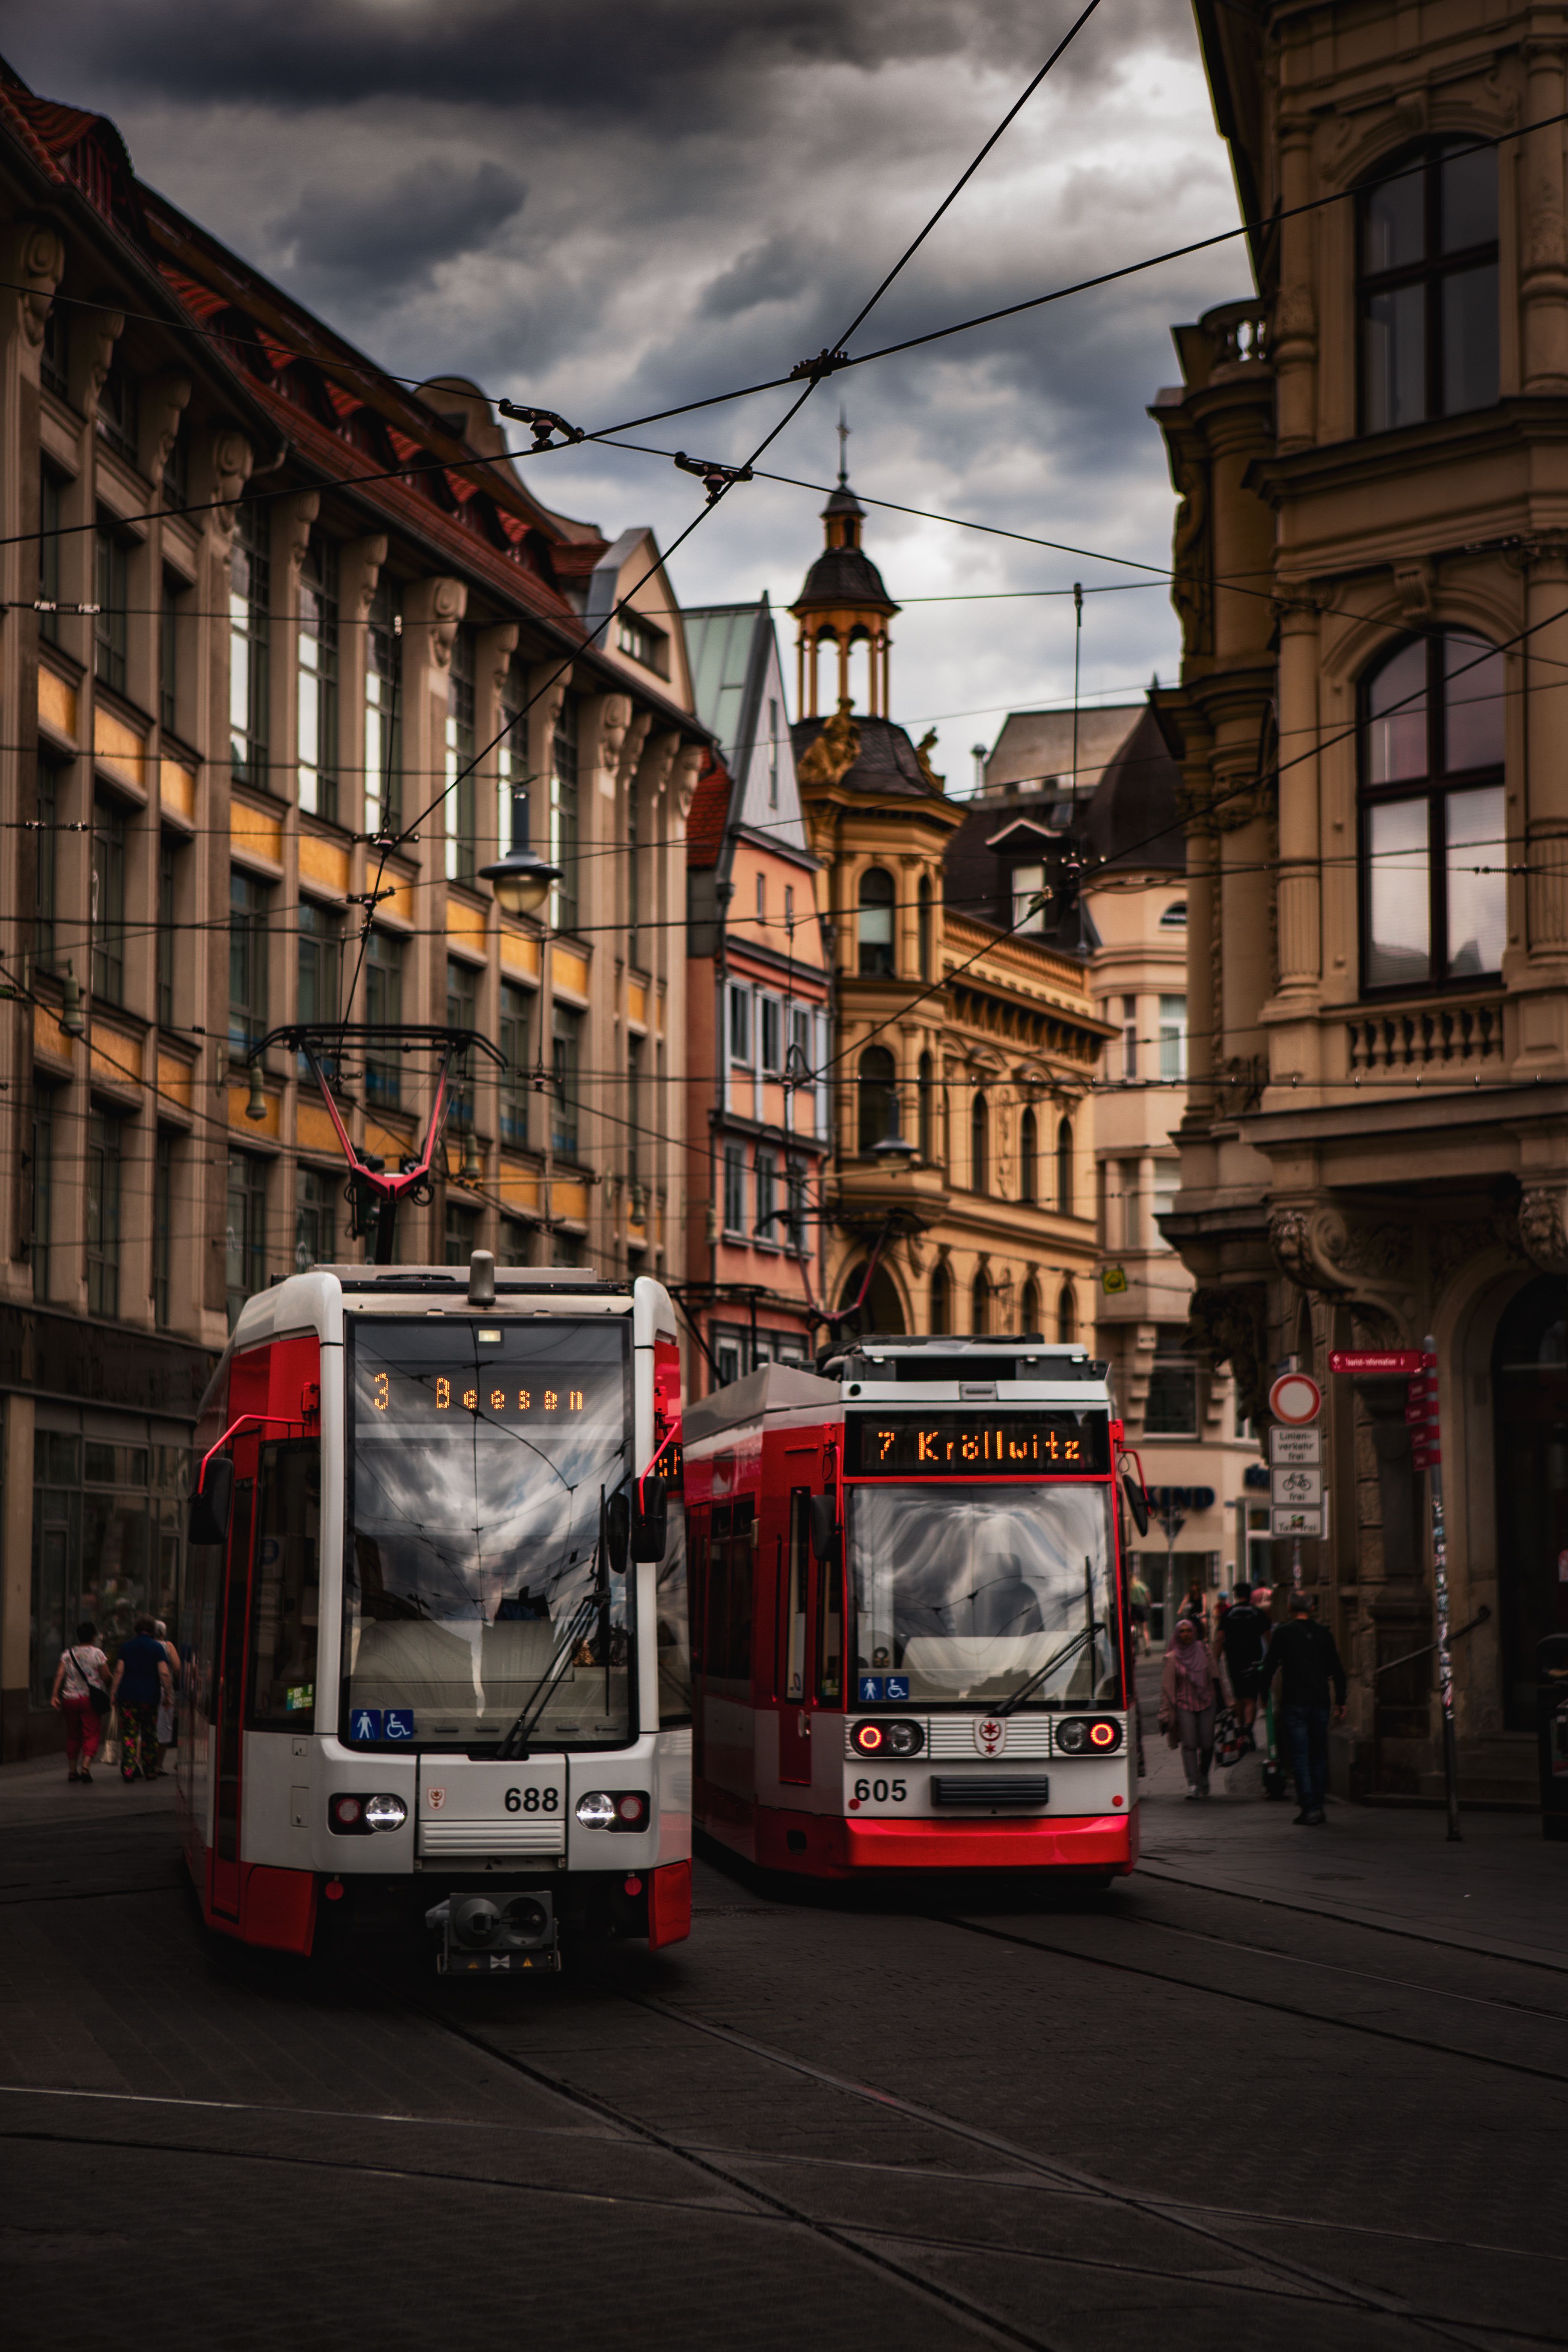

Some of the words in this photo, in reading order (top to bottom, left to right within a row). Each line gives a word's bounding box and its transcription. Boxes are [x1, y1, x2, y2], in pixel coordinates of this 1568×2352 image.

[374, 1373, 389, 1410] 3
[436, 1377, 583, 1410] Beesen
[878, 1432, 895, 1460] 7
[918, 1431, 1080, 1461] Kröllwitz
[1288, 1452, 1304, 1460] frei
[1289, 1492, 1305, 1501] frei
[504, 1787, 559, 1813] 688
[854, 1779, 907, 1802] 605
